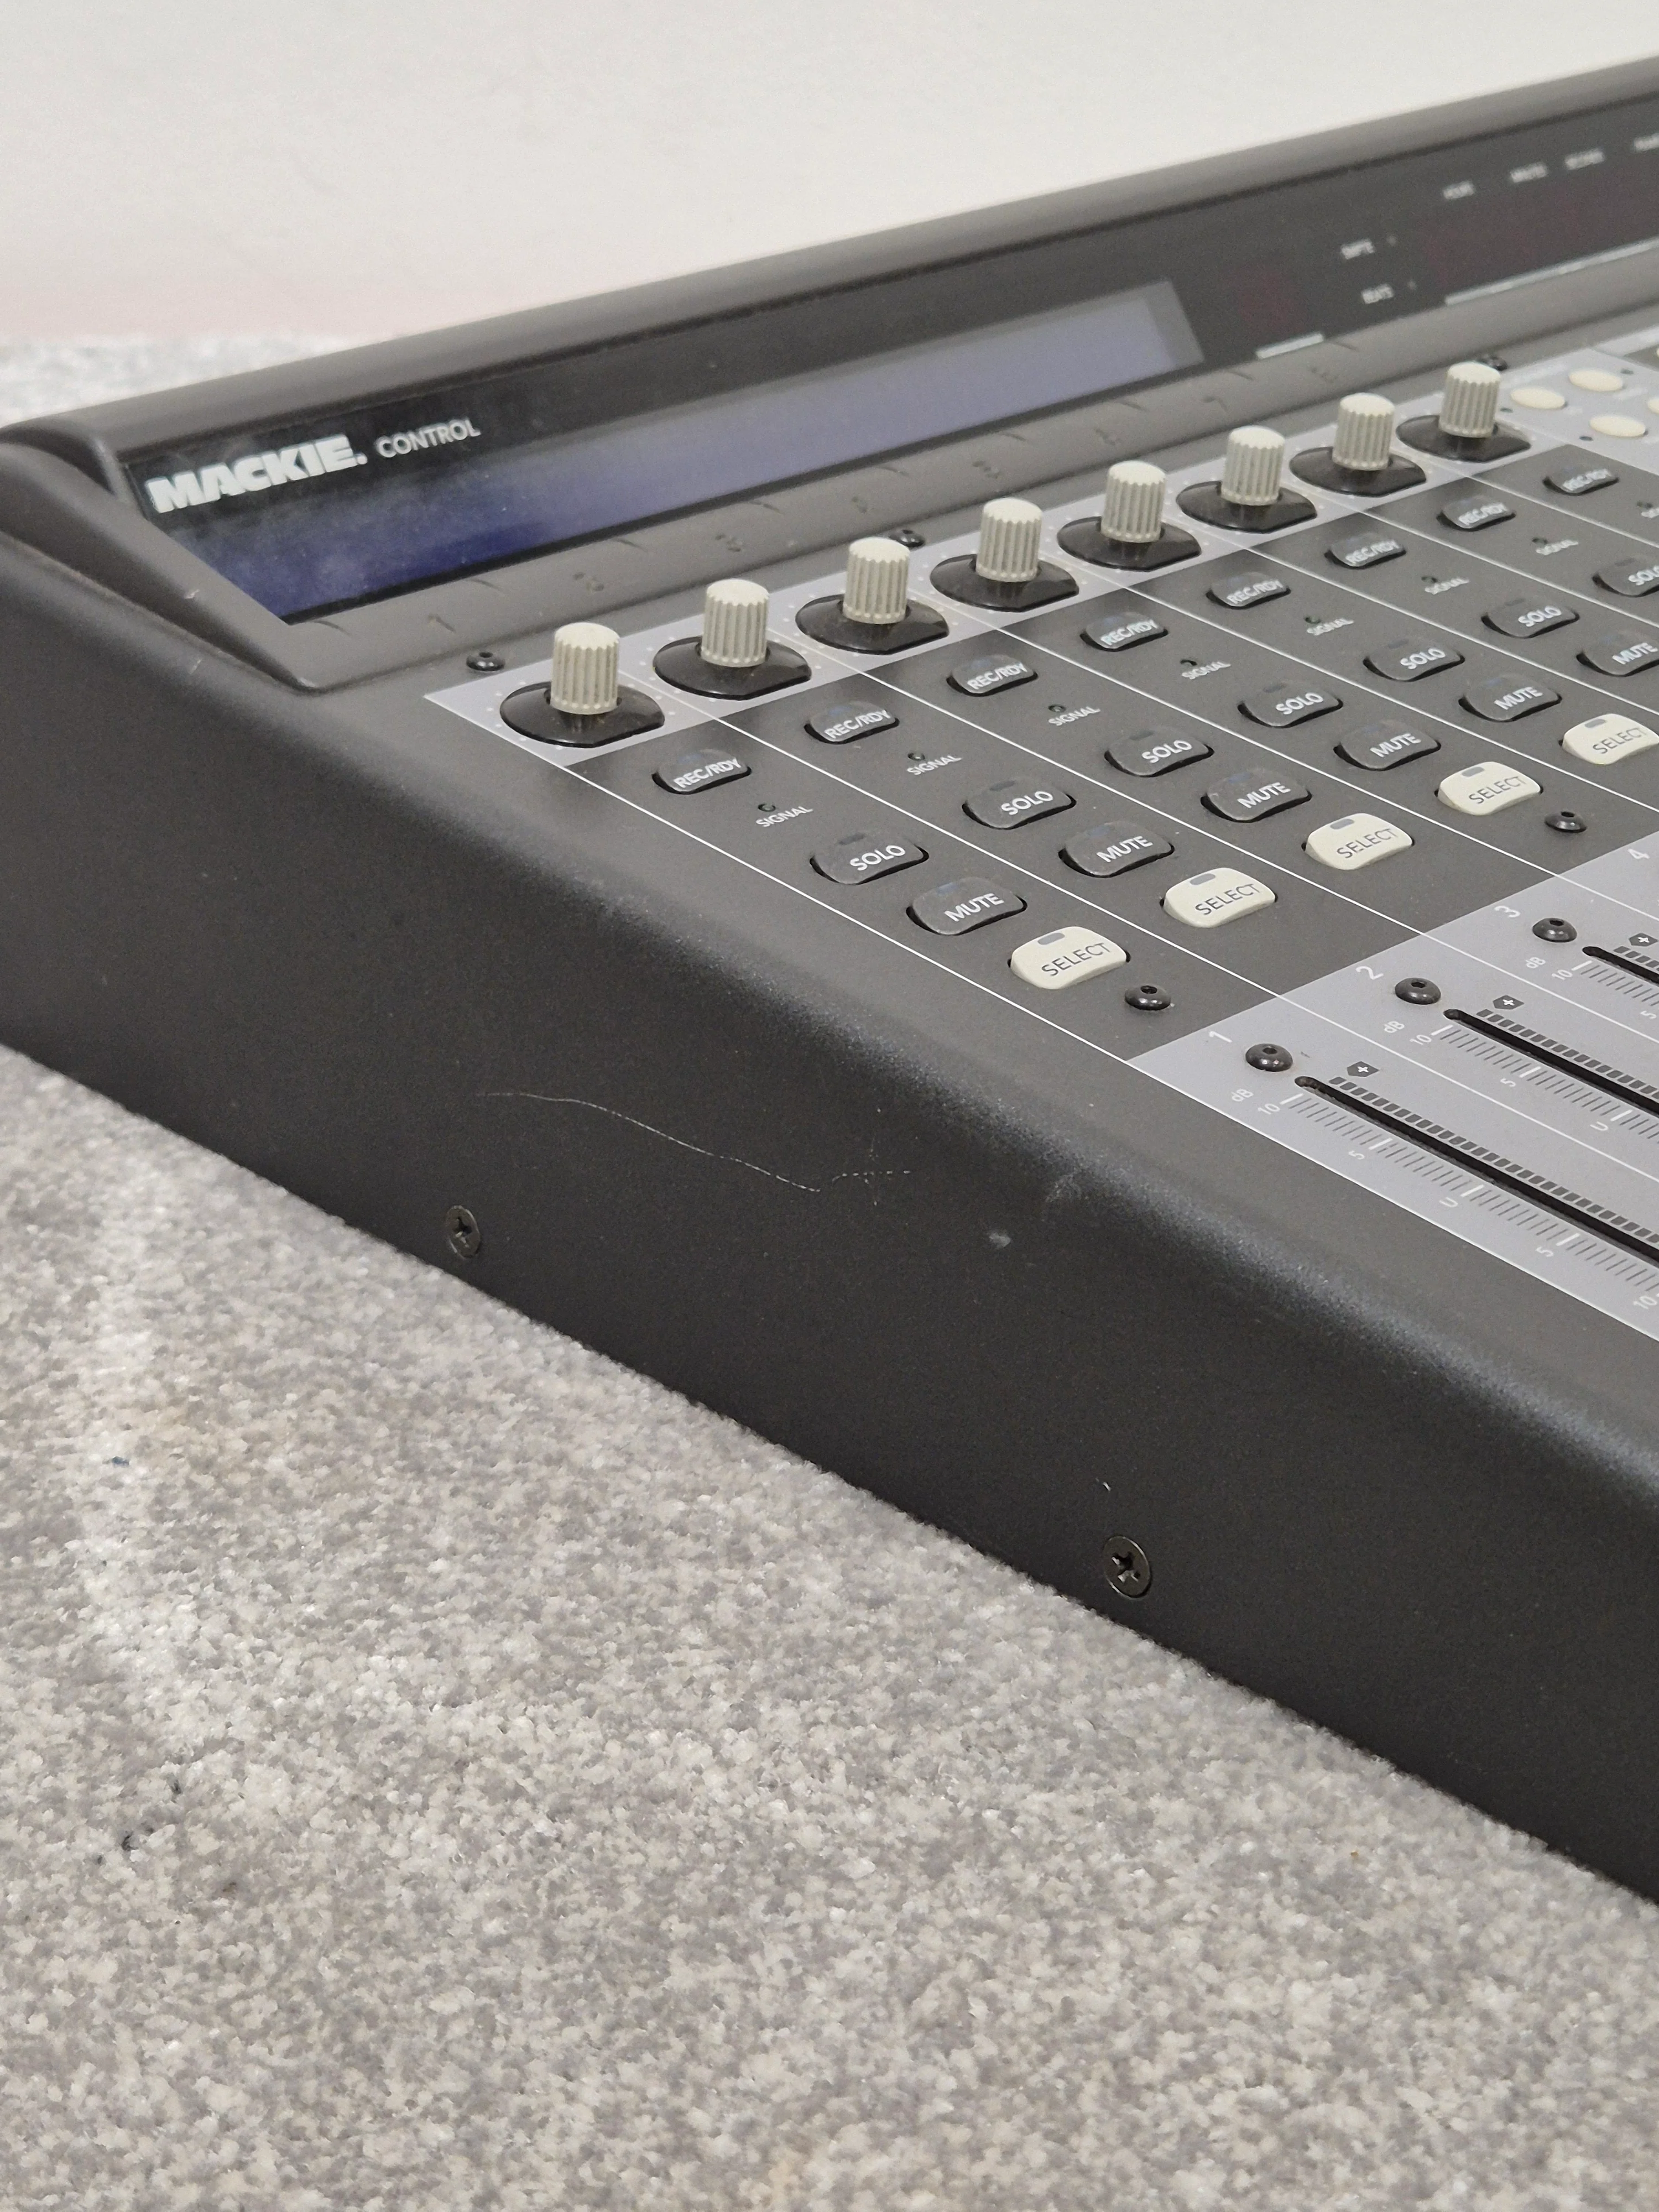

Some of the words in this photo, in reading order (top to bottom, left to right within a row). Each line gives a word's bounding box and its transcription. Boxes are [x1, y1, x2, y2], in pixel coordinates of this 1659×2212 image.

[377, 416, 481, 459] CONTROL
[1518, 606, 1562, 627] SOLO
[1100, 619, 1159, 646] REC/RDY
[1400, 647, 1446, 670] SOLO
[1612, 643, 1658, 664] MUTE
[967, 662, 1027, 690] REC/RDY
[1182, 660, 1231, 680] SIGNAL
[1276, 692, 1323, 715] SOLO
[1494, 686, 1543, 710] MUTE
[824, 709, 891, 739] REC/RDY
[1048, 705, 1100, 726] SIGNAL
[1370, 732, 1421, 758] MUTE
[1593, 727, 1647, 754] SELECT
[1142, 739, 1192, 764] SOLO
[673, 757, 742, 789] REC/RDY
[907, 754, 962, 775] SIGNAL
[1237, 782, 1291, 808] MUTE
[1468, 776, 1527, 805] SELECT
[1001, 790, 1053, 816] SOLO
[755, 806, 813, 827] SIGNAL
[1097, 835, 1154, 863] MUTE
[1336, 828, 1397, 859] SELECT
[1627, 848, 1650, 859] 4
[849, 844, 905, 872] SOLO
[944, 893, 1004, 922] MUTE
[1195, 883, 1260, 916] SELECT
[1495, 905, 1521, 919] 3
[1041, 942, 1112, 976] SELECT
[1525, 957, 1546, 969] dB
[1355, 965, 1384, 980] 2
[1551, 969, 1573, 980] 10
[1641, 1010, 1657, 1020] 5
[1209, 1030, 1233, 1043] 1
[1383, 1019, 1405, 1035] dB
[1409, 1034, 1432, 1046] 10
[1500, 1078, 1516, 1087] 5
[1231, 1088, 1254, 1103] dB
[1257, 1103, 1281, 1116] 10
[1590, 1121, 1609, 1131] U
[1348, 1149, 1366, 1161] 5
[1439, 1197, 1458, 1208] U
[1536, 1246, 1553, 1257] 5
[1632, 1296, 1658, 1310] 10
